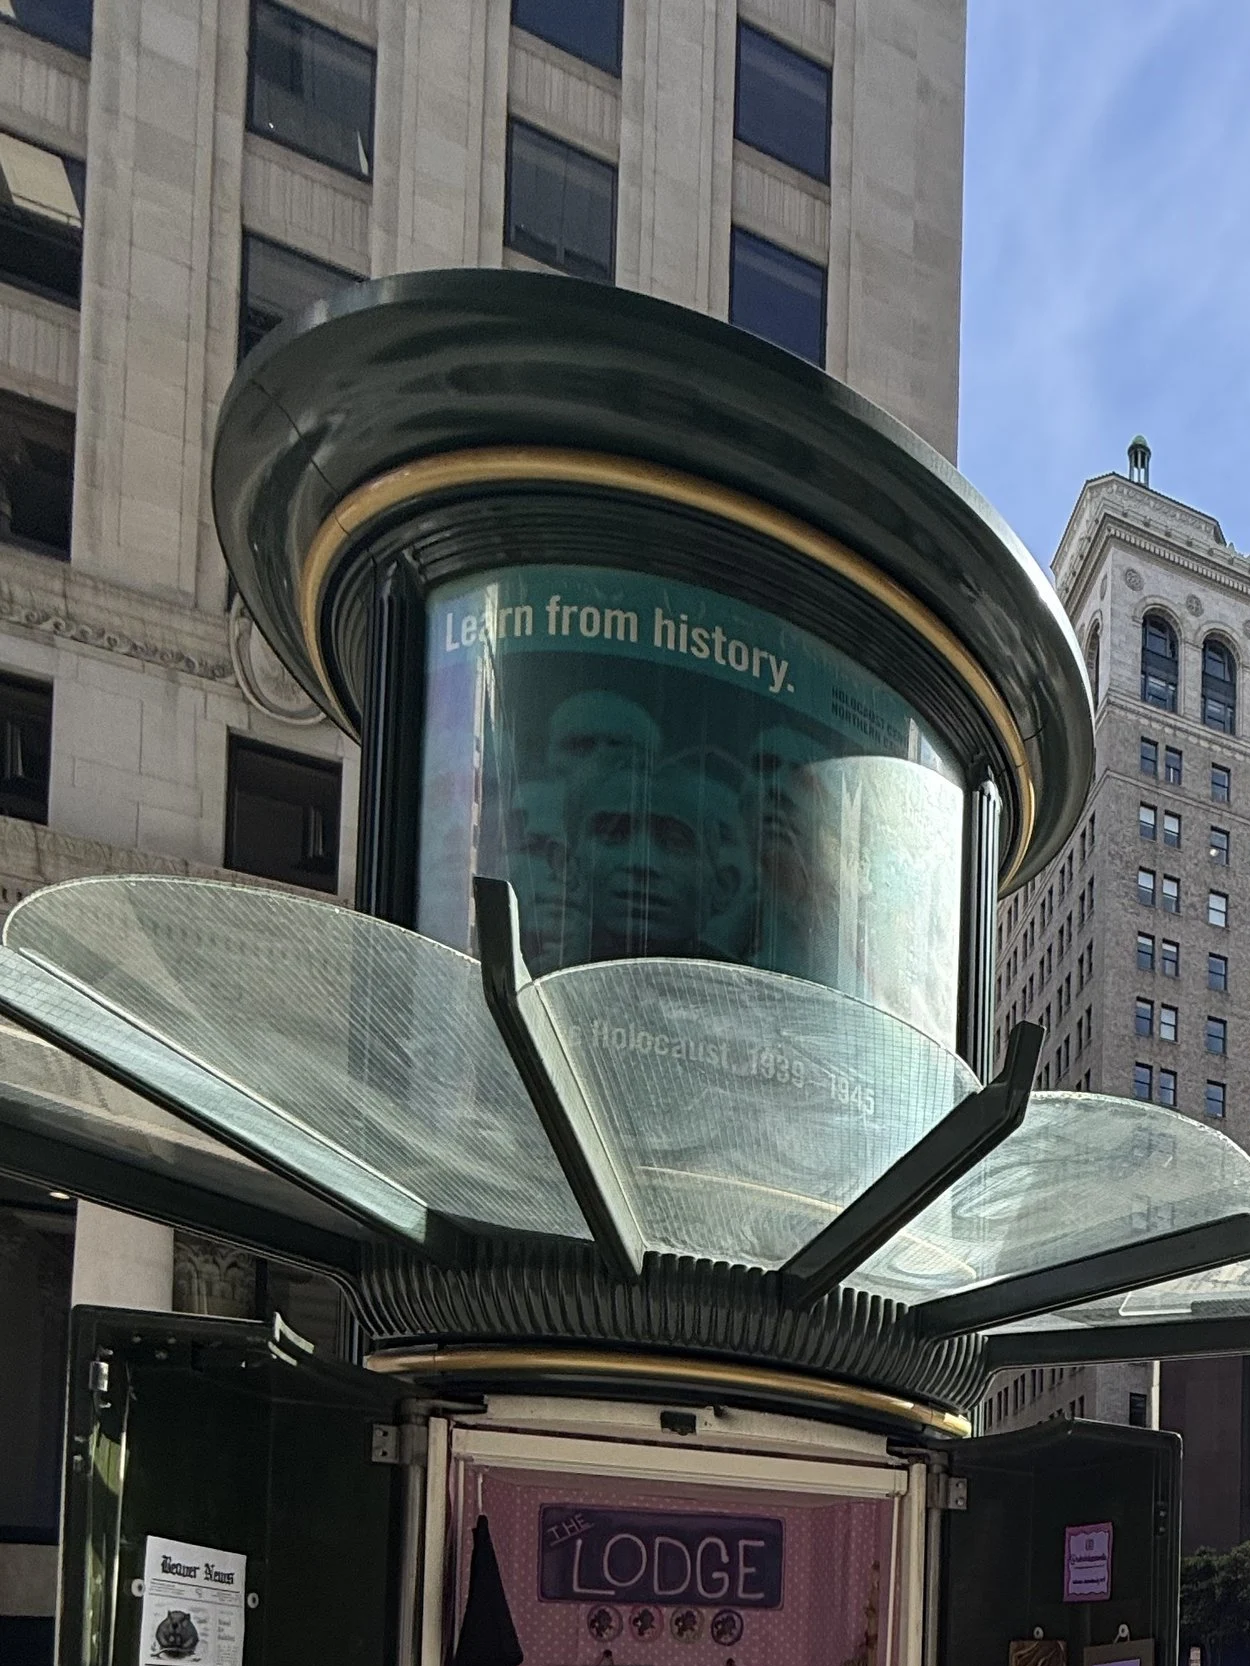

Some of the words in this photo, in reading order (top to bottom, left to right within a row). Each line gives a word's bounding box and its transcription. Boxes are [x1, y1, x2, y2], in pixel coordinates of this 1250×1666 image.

[545, 594, 637, 643] from
[653, 606, 795, 694] history.
[546, 1512, 592, 1542] THE
[572, 1532, 766, 1600] LODGE
